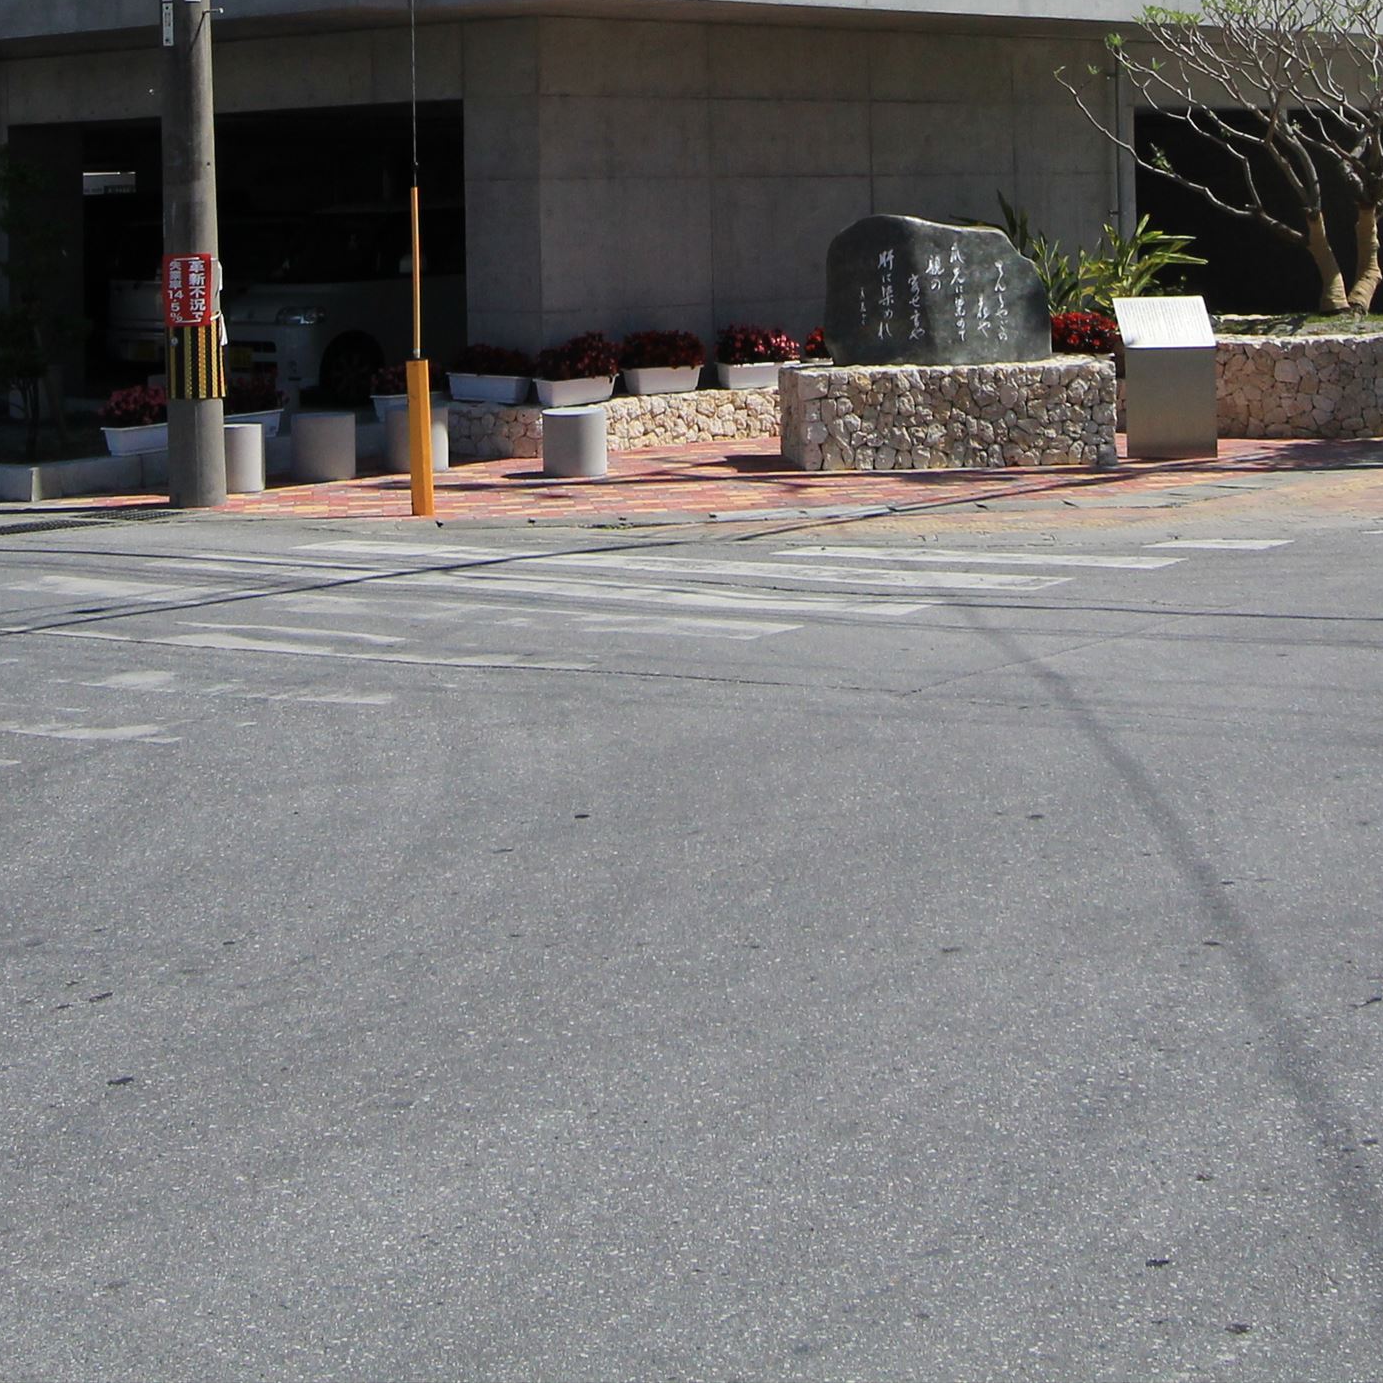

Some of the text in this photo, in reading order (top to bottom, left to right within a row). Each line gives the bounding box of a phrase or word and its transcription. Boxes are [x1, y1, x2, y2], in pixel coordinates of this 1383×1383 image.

[188, 260, 206, 320] 革新不況で
